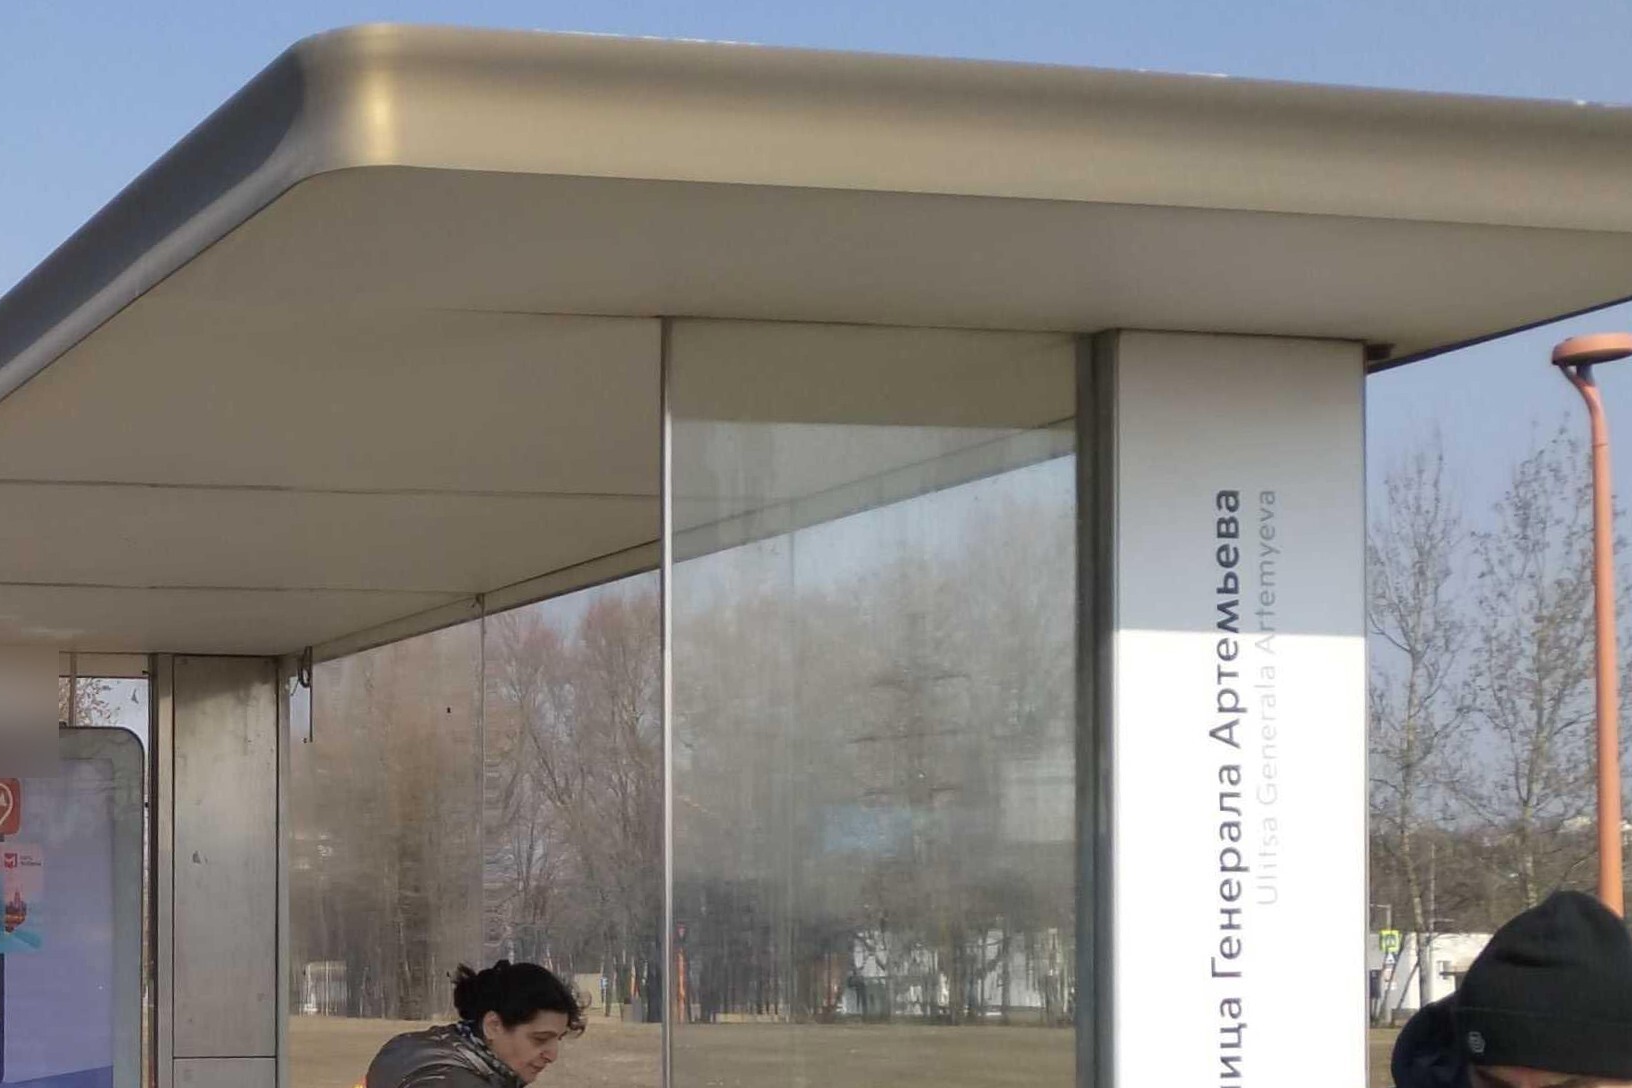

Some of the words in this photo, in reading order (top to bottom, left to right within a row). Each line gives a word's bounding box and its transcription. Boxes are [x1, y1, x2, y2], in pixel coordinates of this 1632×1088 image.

[1209, 488, 1248, 749] Артемьева
[1255, 490, 1281, 655] Artemyeva
[1254, 665, 1277, 806] Generala
[1211, 763, 1250, 978] Генерала
[1256, 816, 1278, 905] Ulitsa
